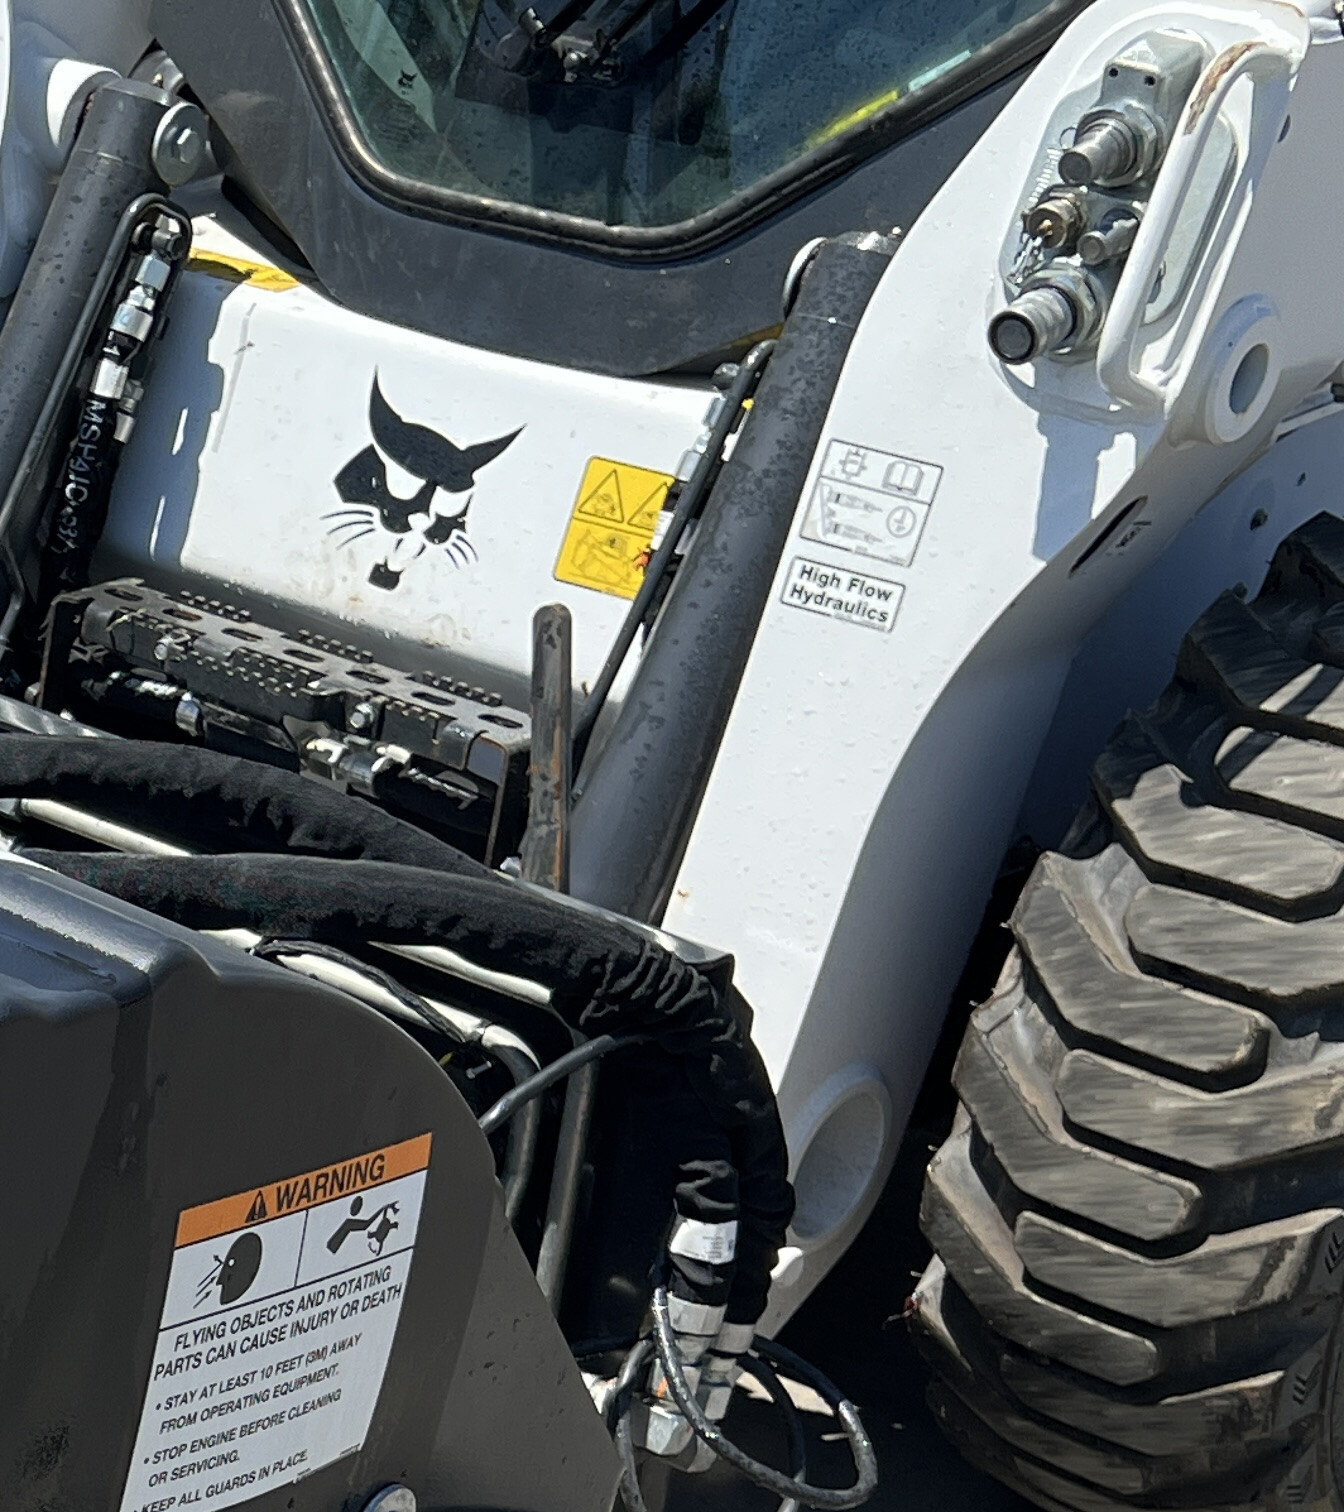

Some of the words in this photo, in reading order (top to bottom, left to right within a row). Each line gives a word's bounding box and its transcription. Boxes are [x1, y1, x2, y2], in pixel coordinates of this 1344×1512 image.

[790, 583, 888, 623] Hydraulics
[799, 564, 841, 589] High
[846, 577, 892, 602] Flow
[276, 1153, 385, 1213] WARNING
[153, 1352, 202, 1382] PARTS
[205, 1343, 236, 1365] CAN
[239, 1324, 288, 1355] CAUSE
[290, 1306, 339, 1339] INJURY
[340, 1299, 360, 1321] OR
[361, 1282, 403, 1314] DEATH
[174, 1321, 227, 1353] FLYING
[229, 1299, 294, 1335] OBJECTS
[295, 1287, 326, 1315] AND
[327, 1265, 392, 1305] ROTATING
[159, 1414, 197, 1436] FROM
[200, 1390, 271, 1423] OPERATING
[272, 1361, 340, 1400] EQUIPMENT.
[164, 1388, 198, 1412] STAY
[198, 1383, 217, 1401] AT
[218, 1370, 258, 1395] LEAST
[260, 1364, 274, 1382] 10
[275, 1353, 305, 1376] FEET
[329, 1332, 363, 1358] AWAY
[152, 1446, 188, 1466] STOP
[189, 1427, 237, 1455] ENGINE
[238, 1409, 286, 1440] BEFORE
[287, 1387, 343, 1423] CLEANING
[148, 1471, 168, 1489] OR
[170, 1448, 241, 1483] SERVICING.
[177, 1488, 203, 1507] ALL
[205, 1470, 257, 1499] GUARDS
[258, 1465, 271, 1482] IN
[272, 1447, 309, 1476] PLACE
